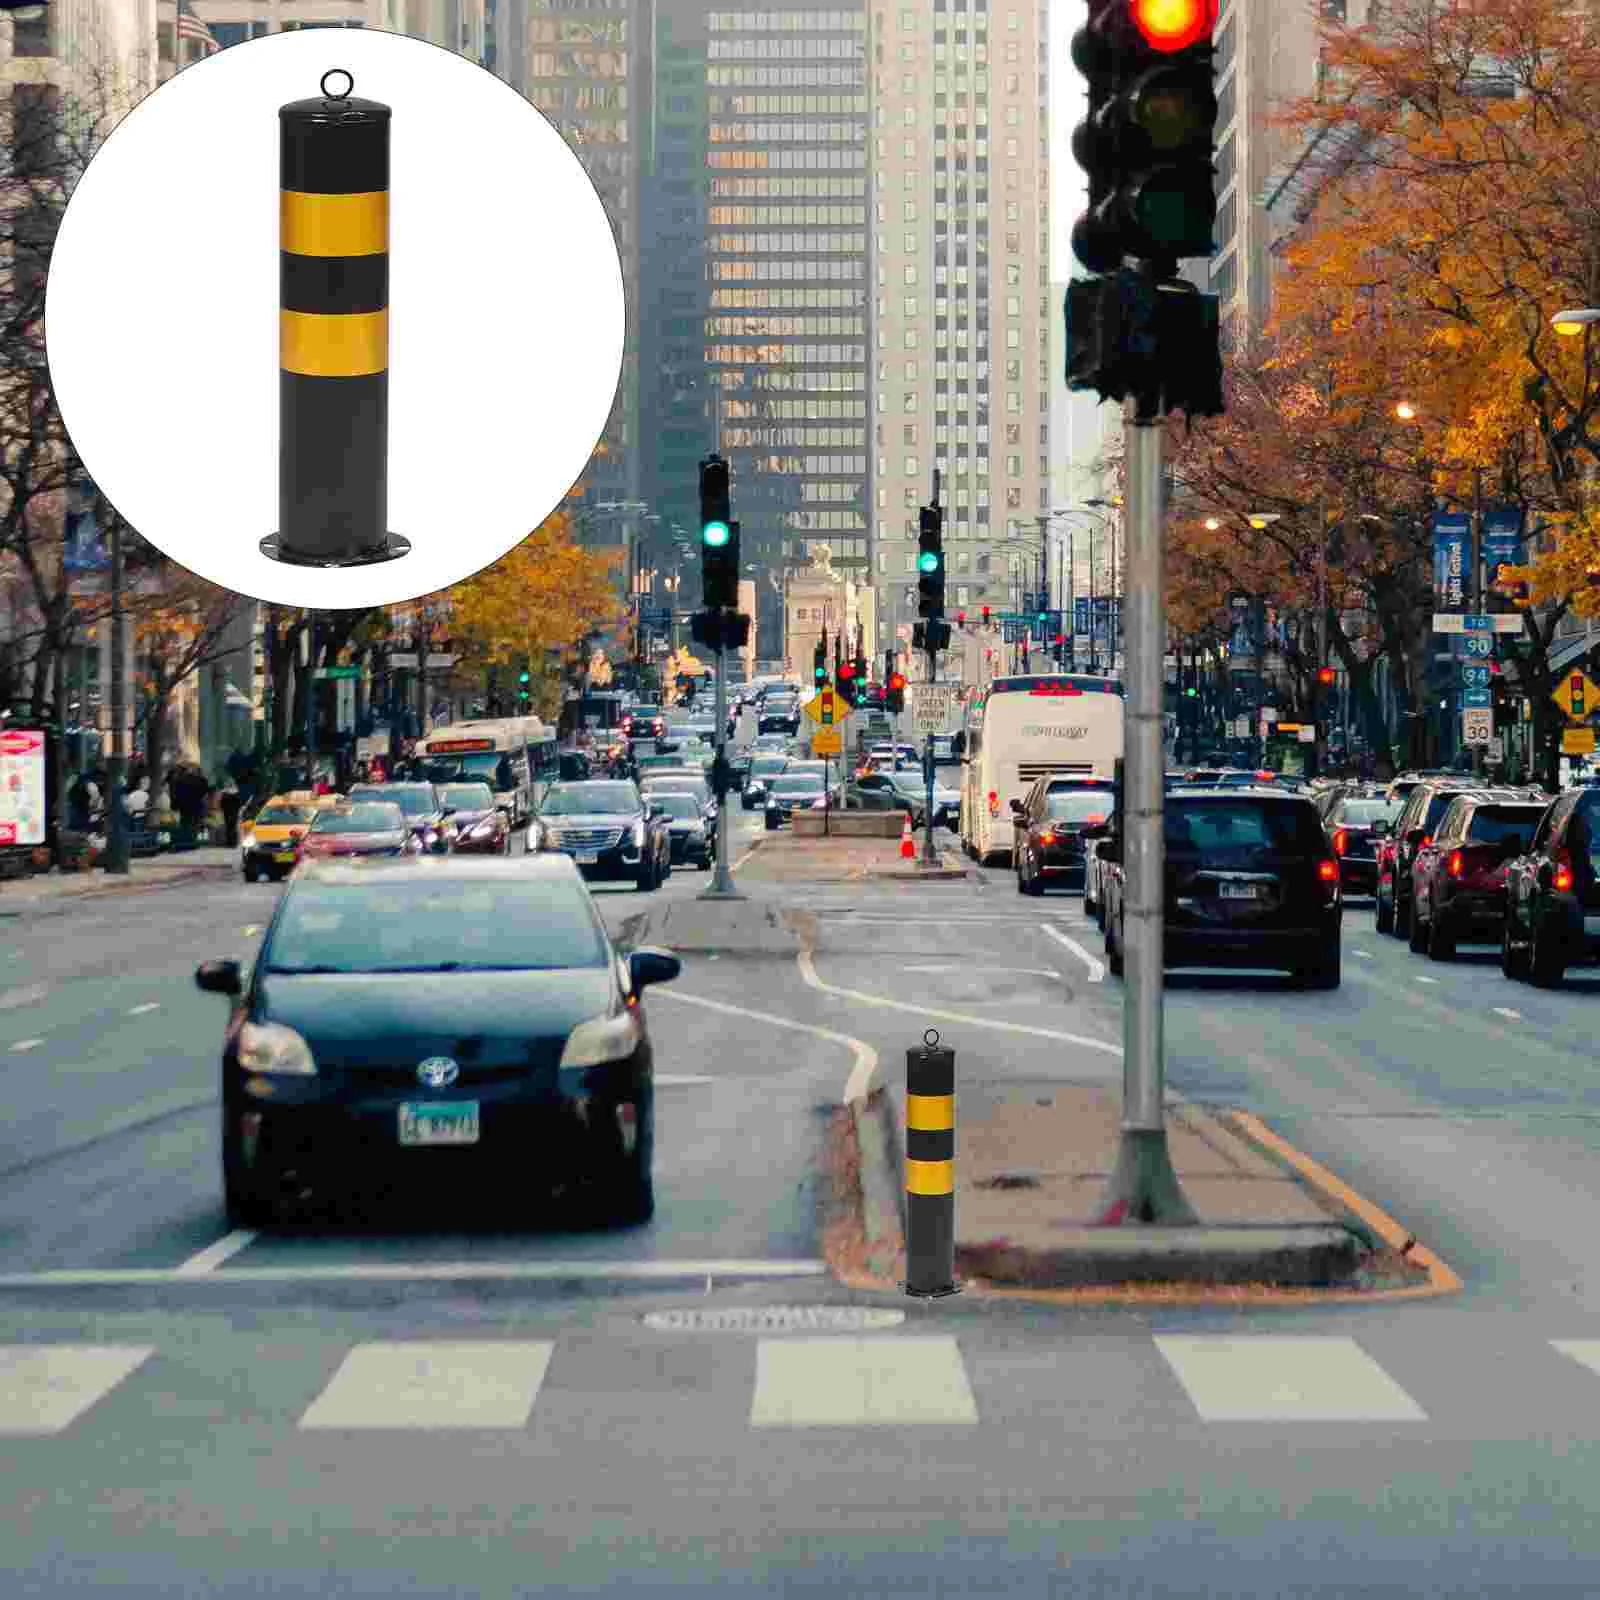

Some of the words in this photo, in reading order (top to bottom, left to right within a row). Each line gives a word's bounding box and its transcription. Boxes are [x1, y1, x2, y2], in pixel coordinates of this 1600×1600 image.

[1467, 639, 1489, 658] 90
[1465, 668, 1487, 684] 94
[1467, 726, 1489, 740] 30
